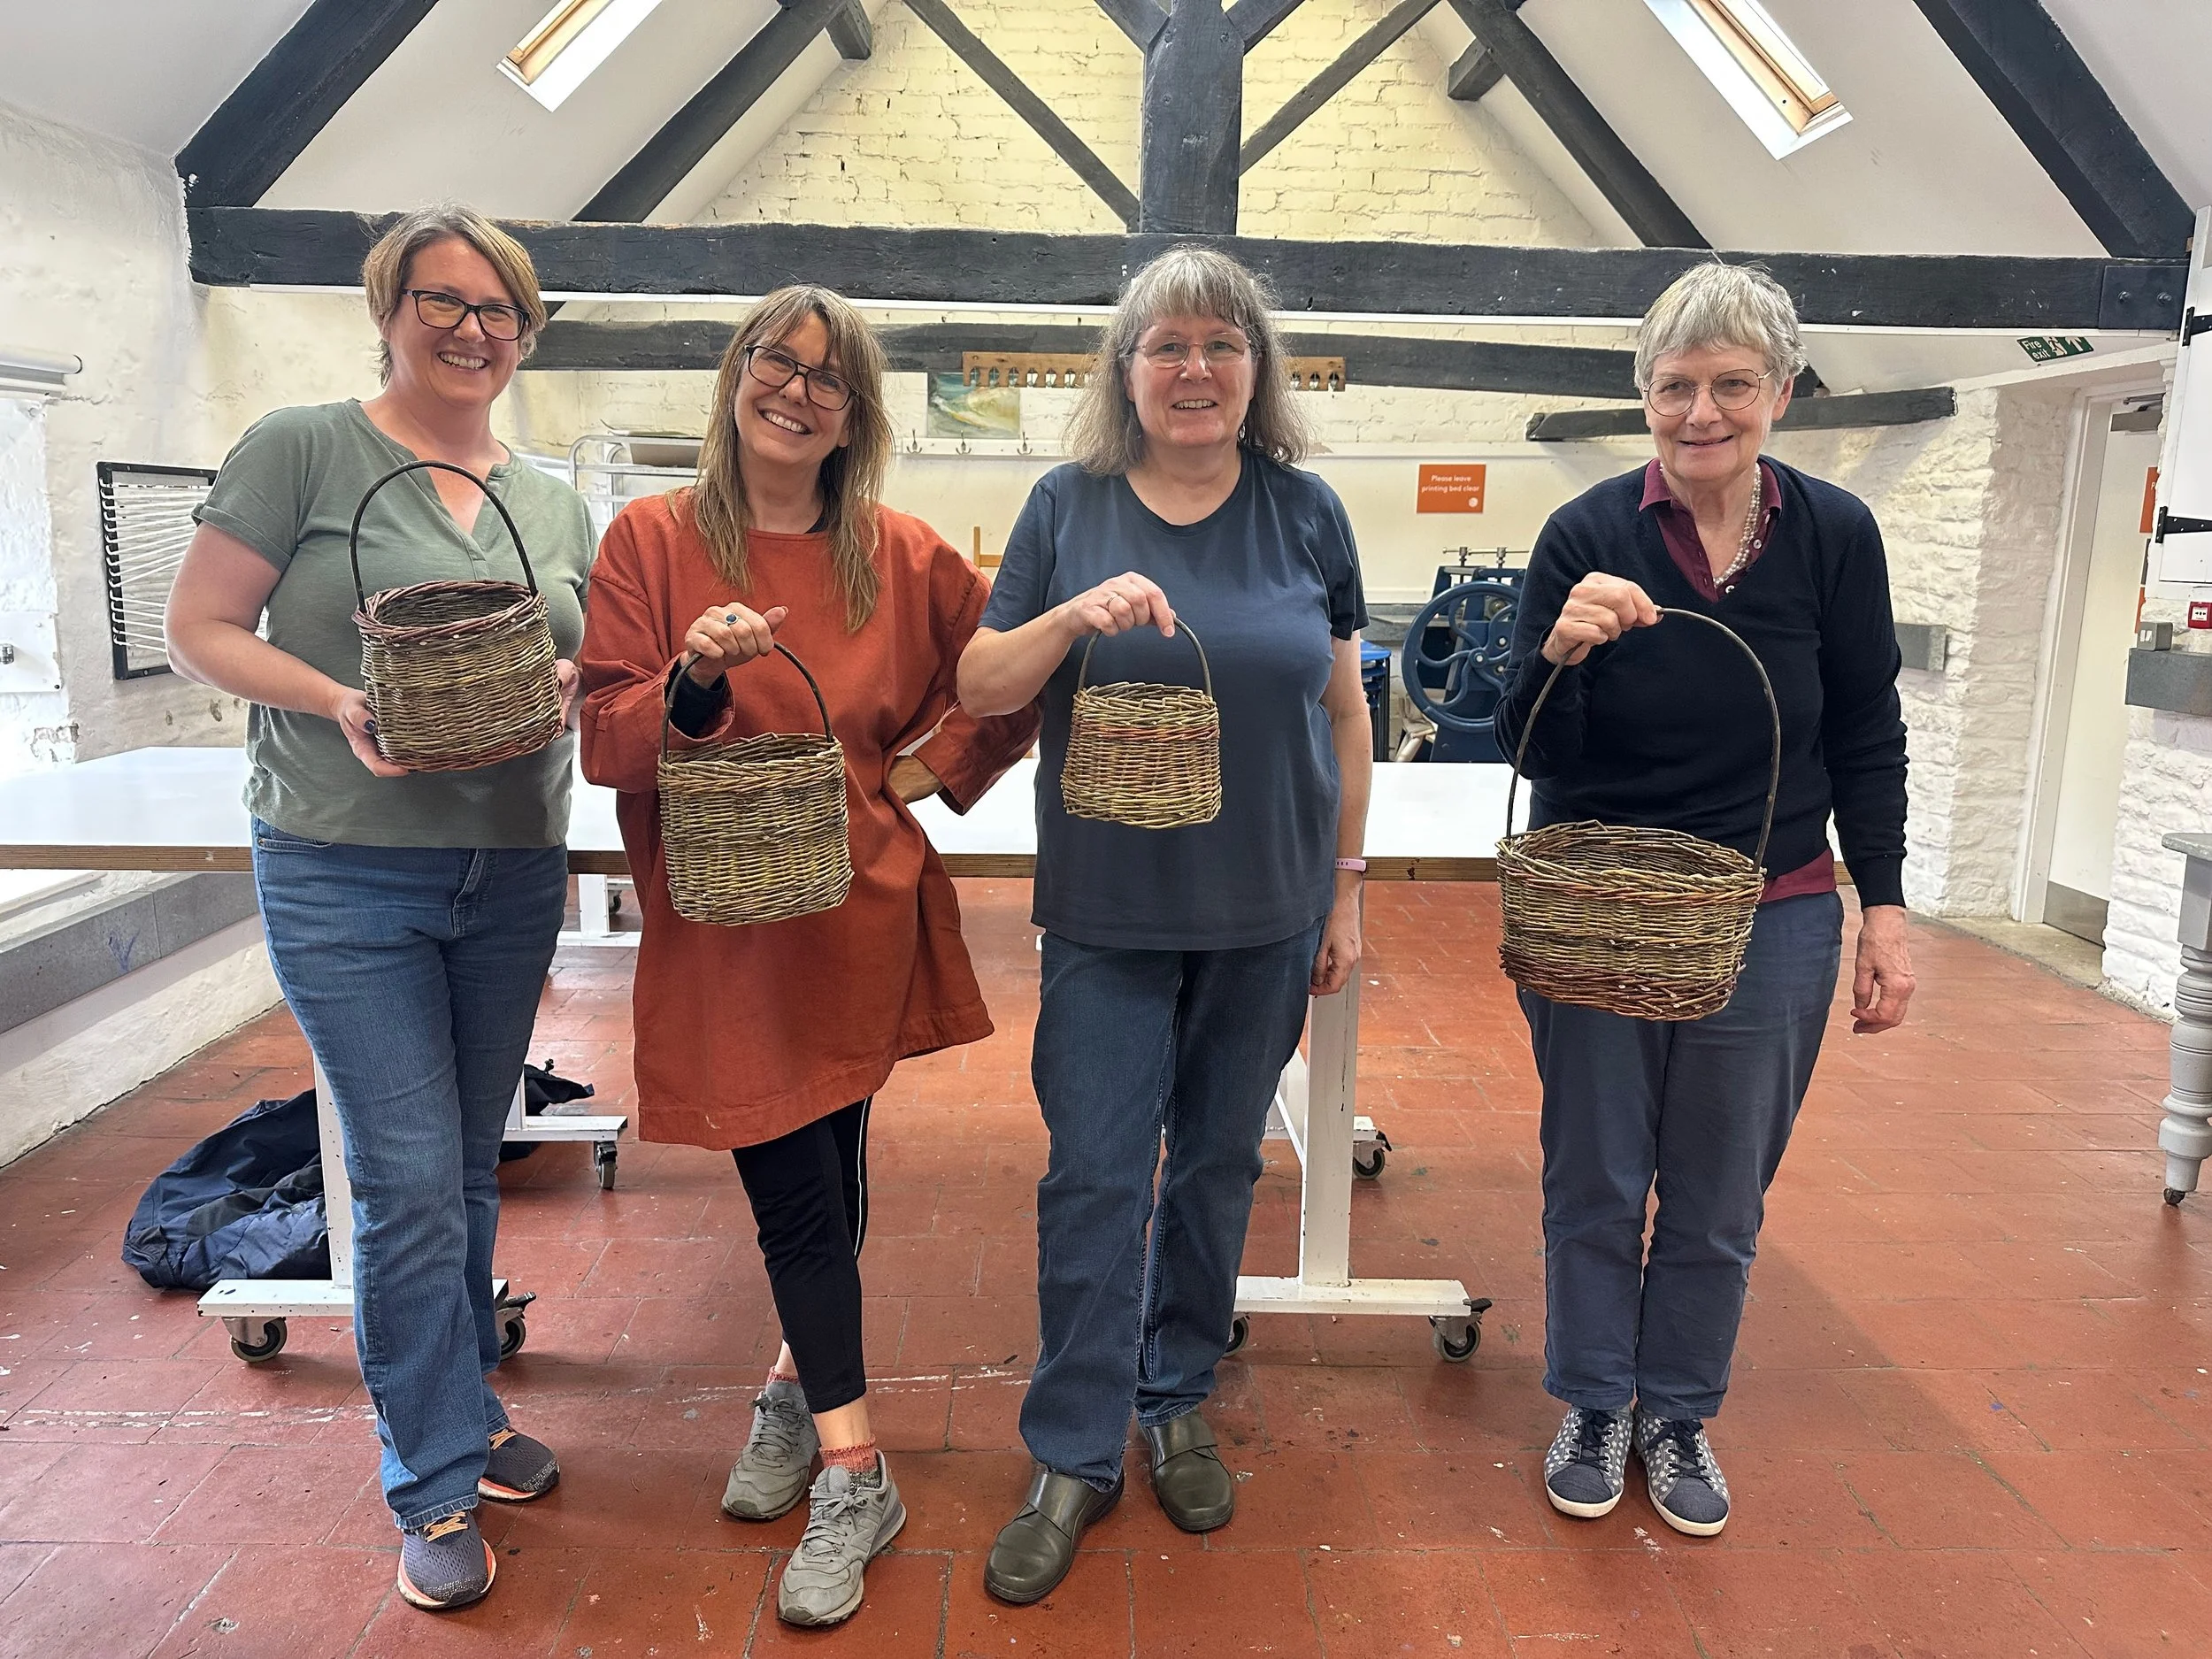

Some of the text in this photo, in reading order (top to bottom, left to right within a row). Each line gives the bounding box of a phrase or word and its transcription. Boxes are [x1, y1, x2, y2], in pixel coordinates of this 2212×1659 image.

[2022, 340, 2042, 350] Fire
[2032, 349, 2051, 360] exit
[1421, 485, 1449, 494] printing
